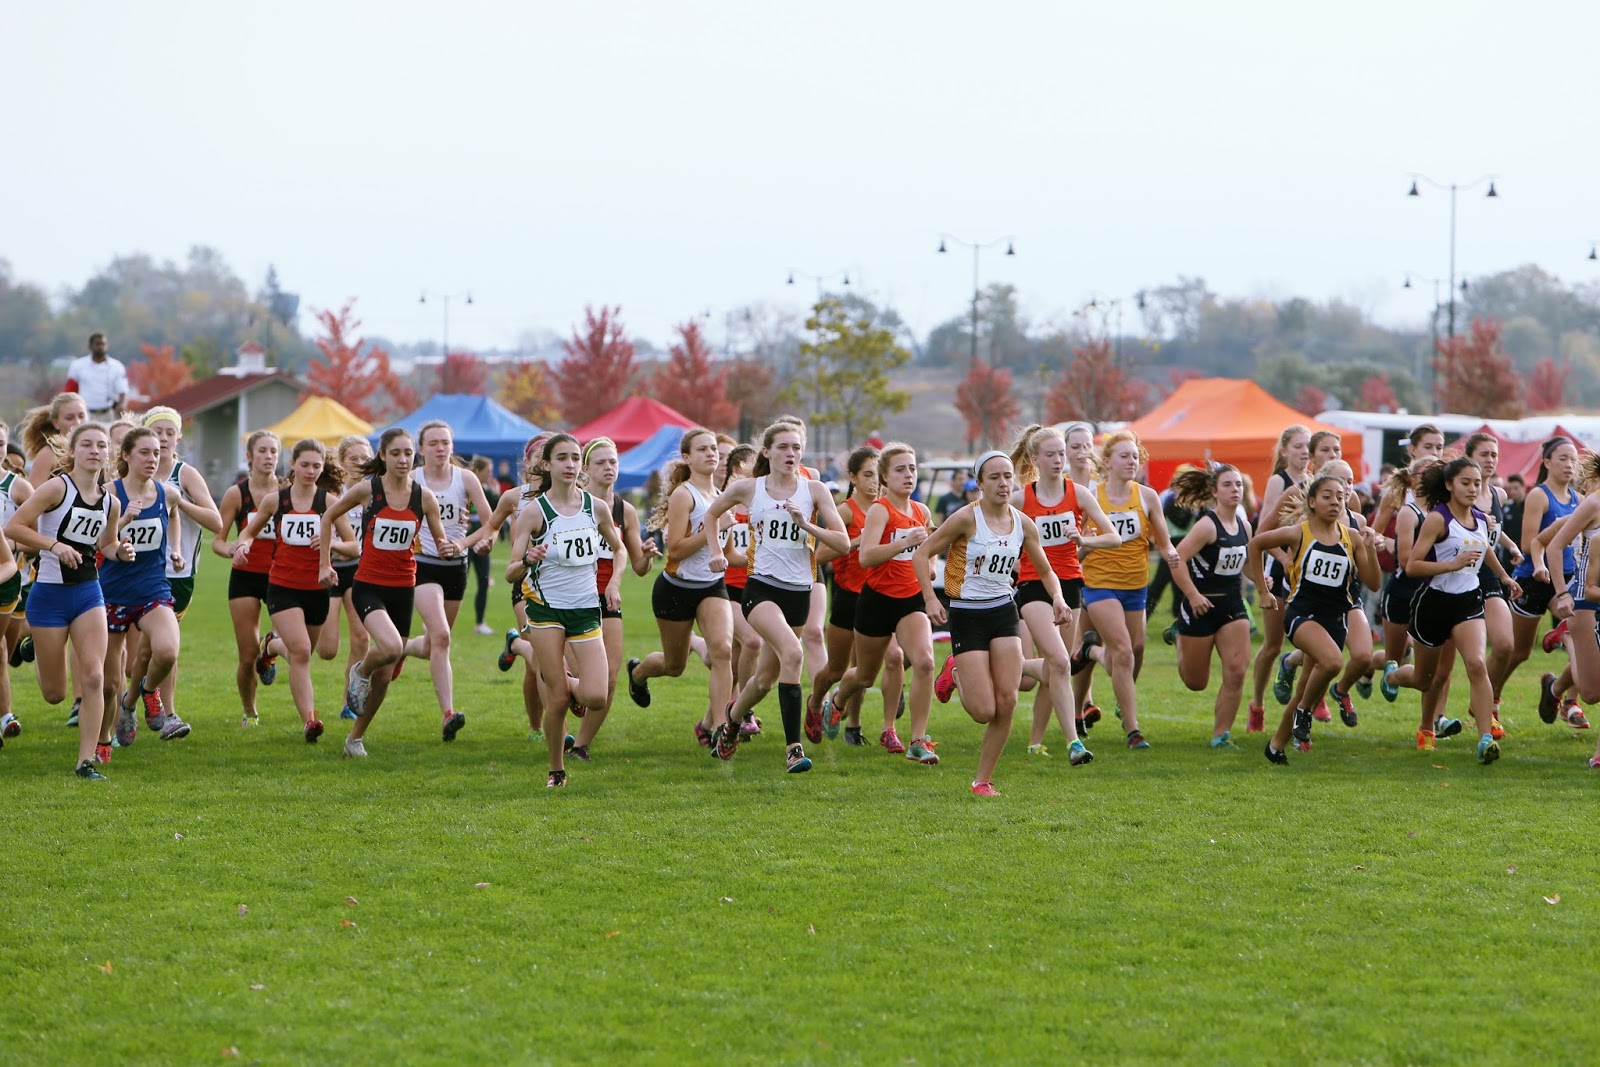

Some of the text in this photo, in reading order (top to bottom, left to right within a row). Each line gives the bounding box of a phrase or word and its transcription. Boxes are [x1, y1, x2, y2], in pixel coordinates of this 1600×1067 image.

[438, 503, 454, 520] 23
[72, 515, 102, 538] 716
[127, 526, 157, 545] 327
[286, 521, 315, 540] 745
[379, 525, 409, 545] 750
[769, 519, 800, 542] 818
[1111, 518, 1135, 536] 75
[564, 536, 594, 559] 781
[988, 554, 1015, 575] 819
[1222, 553, 1243, 570] 337
[1312, 558, 1342, 580] 815
